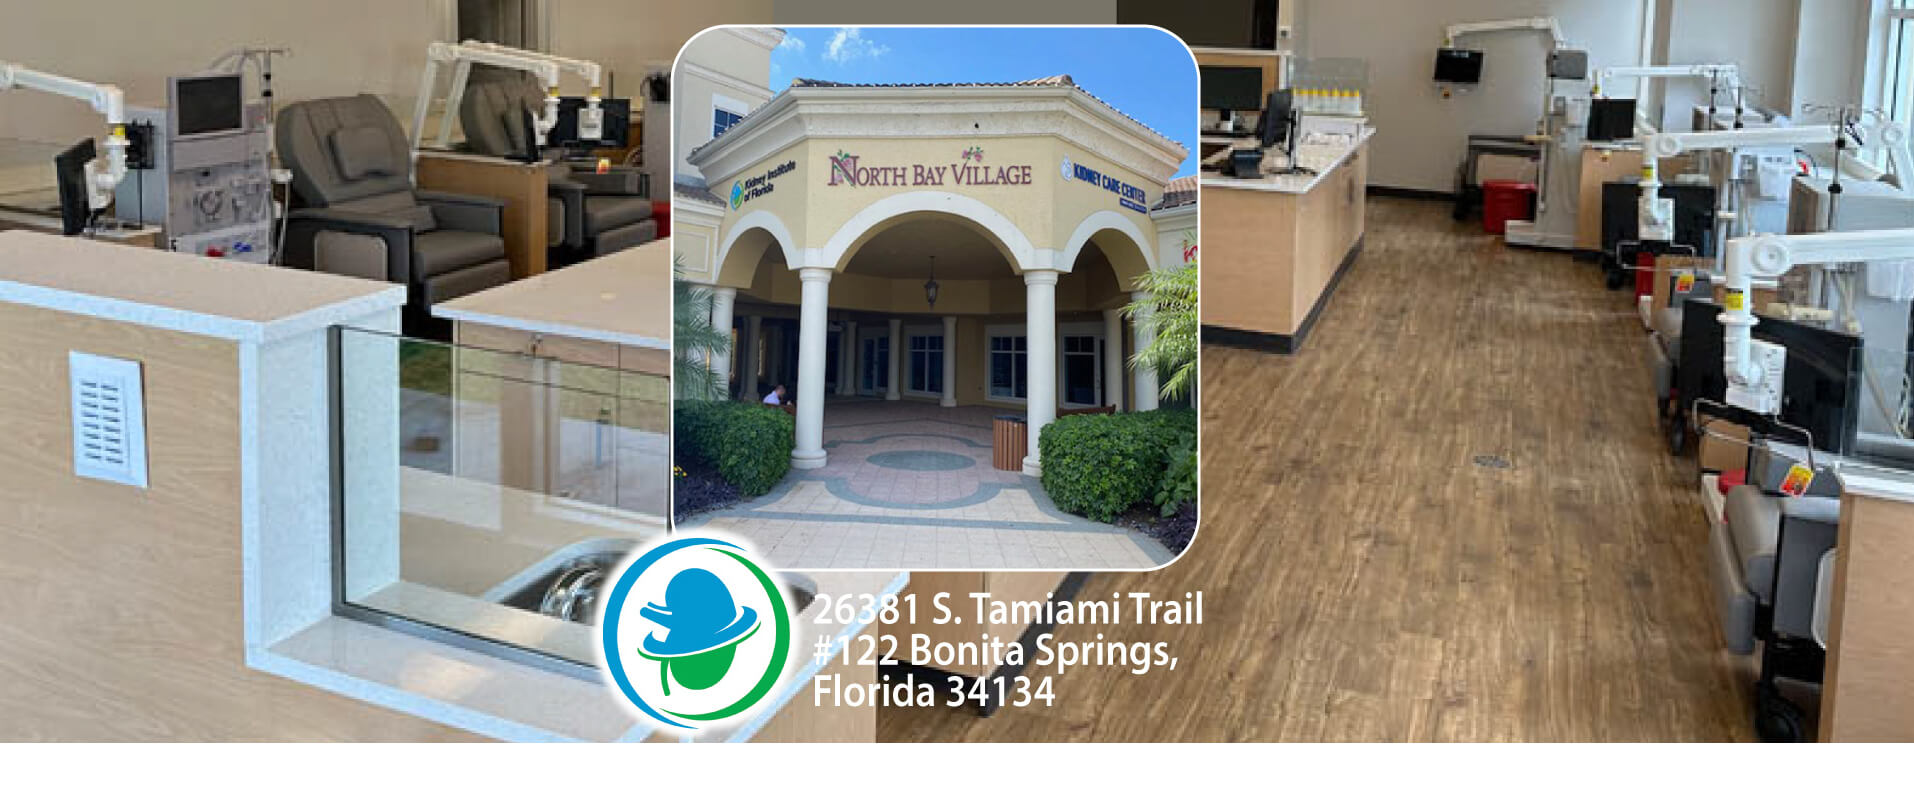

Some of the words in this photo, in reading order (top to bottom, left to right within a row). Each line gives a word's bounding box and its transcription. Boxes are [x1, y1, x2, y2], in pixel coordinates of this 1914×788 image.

[745, 174, 766, 190] Kidney
[767, 160, 796, 180] Institute
[912, 164, 947, 186] BAY
[951, 163, 1033, 185] VILLAGE
[1073, 163, 1101, 187] KIDNEY
[1102, 174, 1121, 195] CARE
[1121, 182, 1146, 205] CENTER
[744, 190, 750, 202] of
[751, 182, 774, 199] Florida
